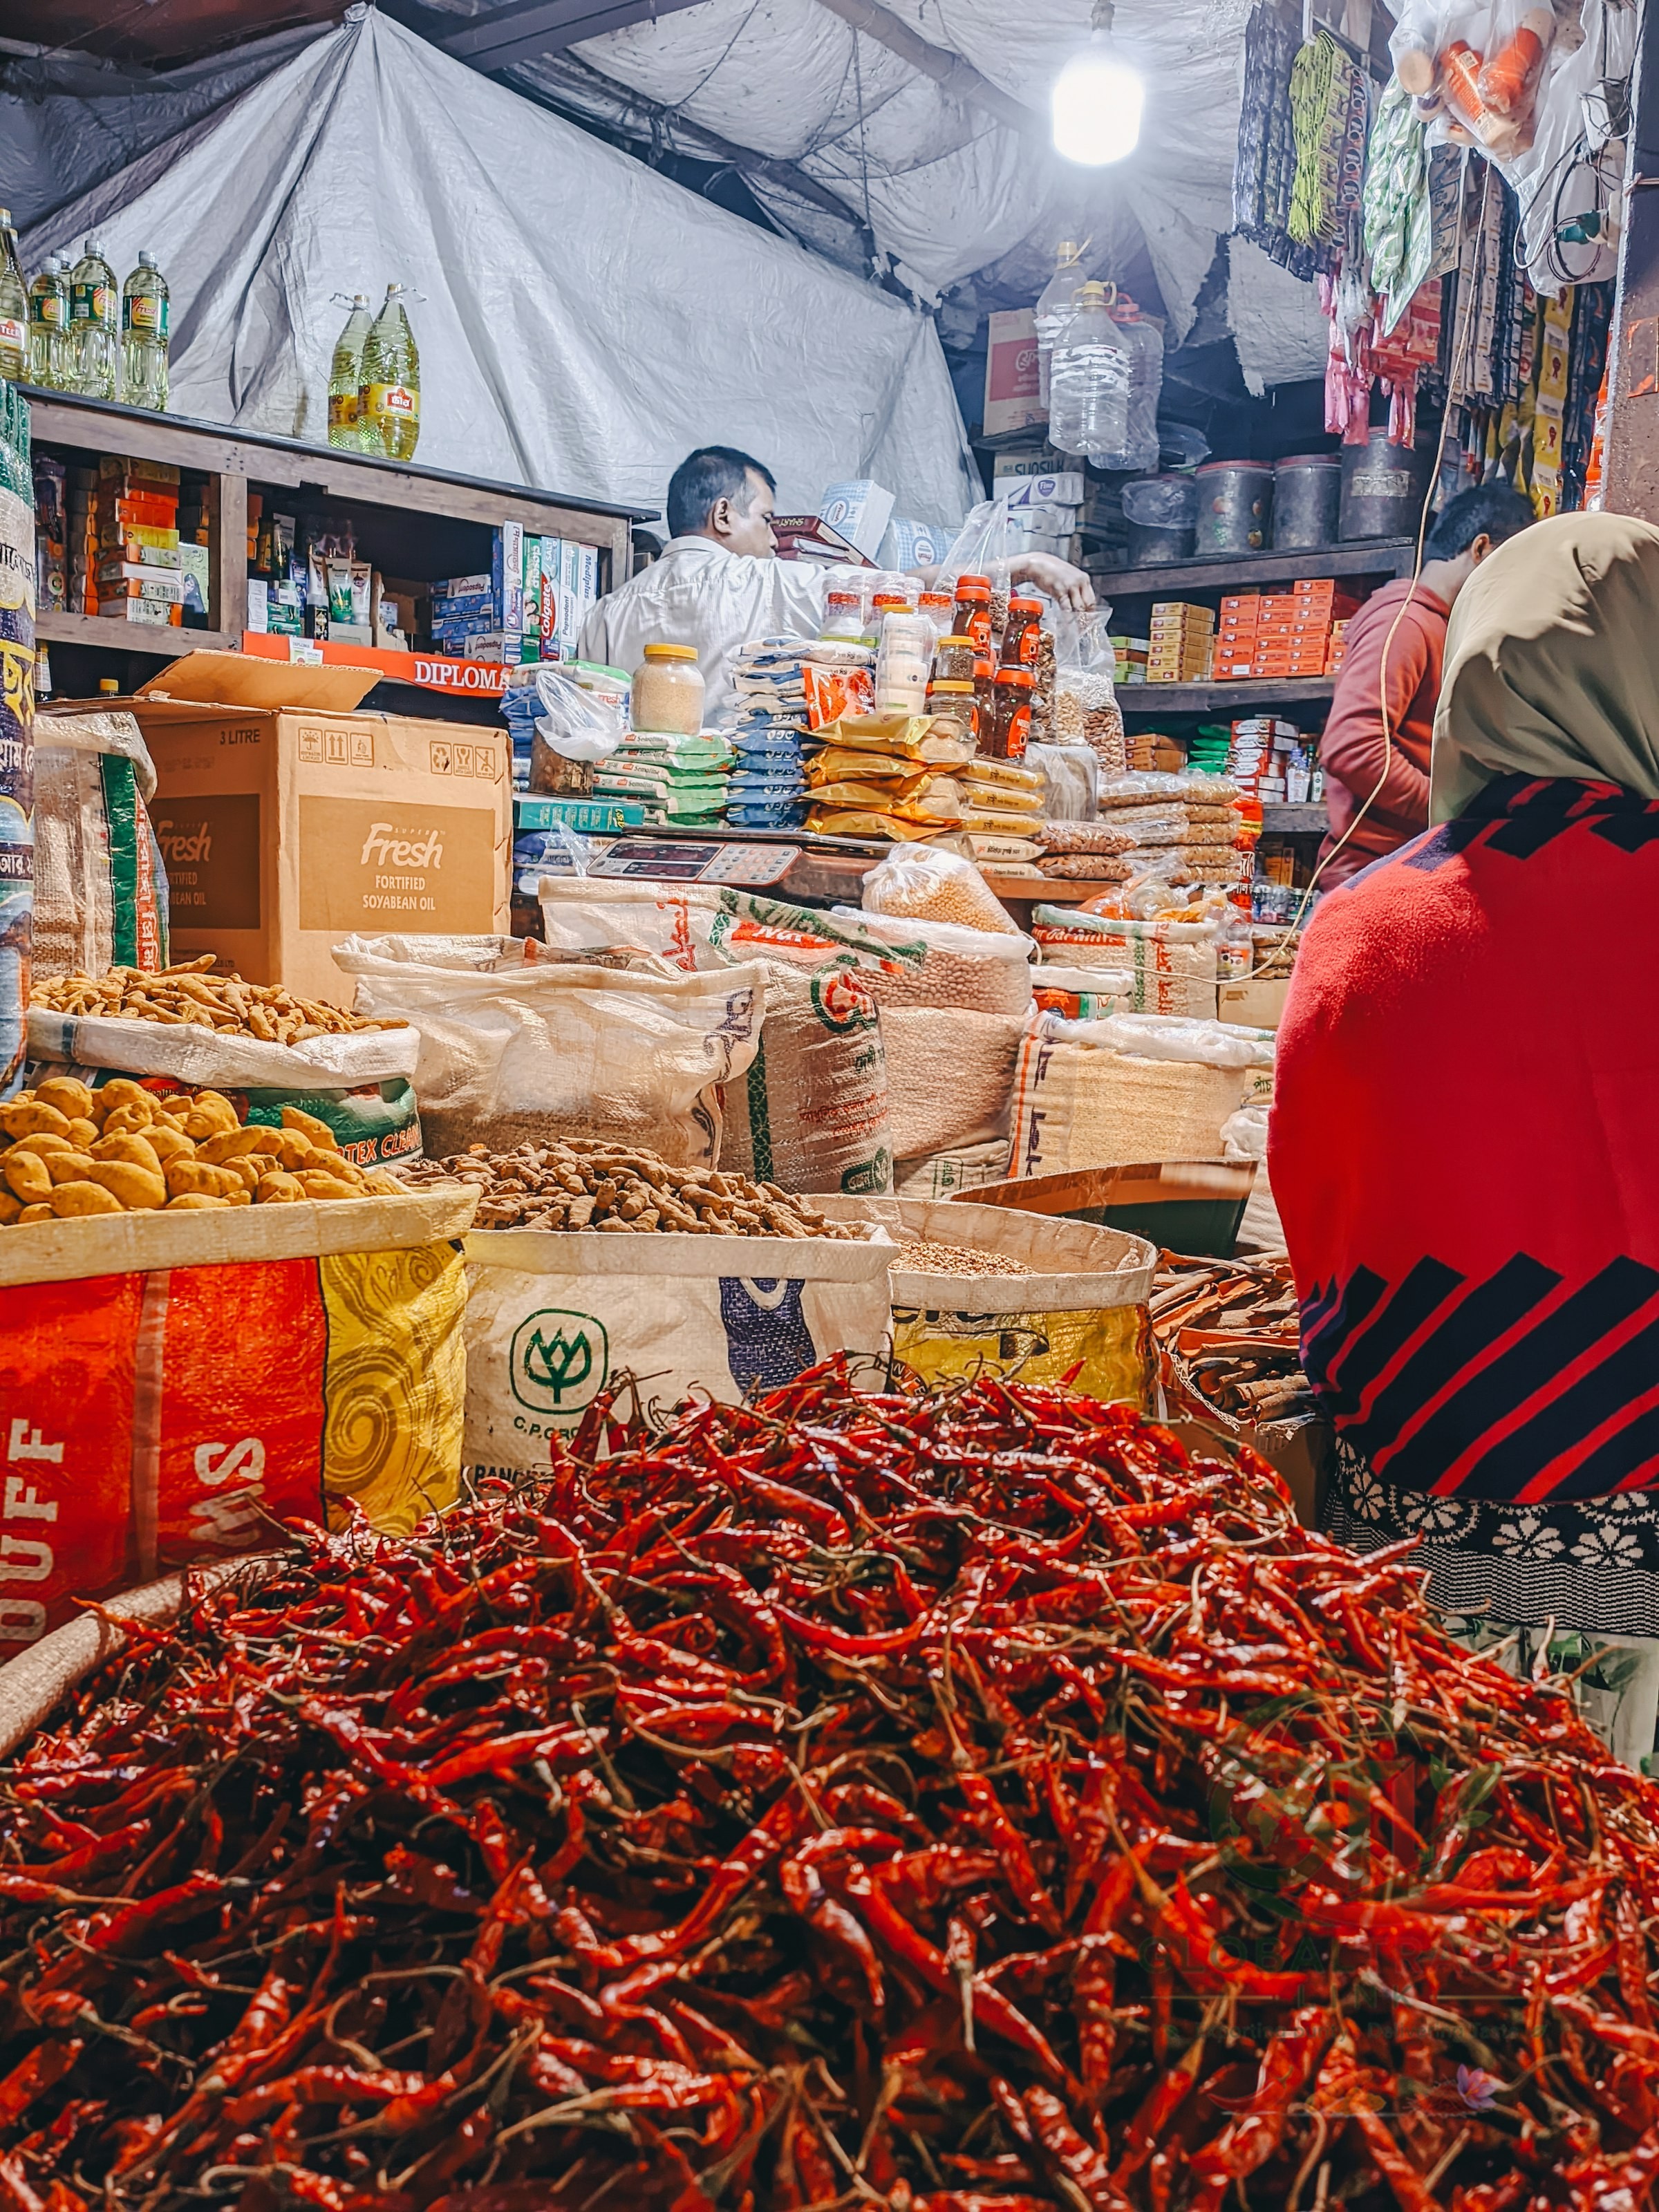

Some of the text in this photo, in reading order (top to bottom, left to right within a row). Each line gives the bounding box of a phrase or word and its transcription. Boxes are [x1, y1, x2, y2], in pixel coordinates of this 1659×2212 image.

[778, 517, 805, 527] SMART
[545, 540, 553, 561] SALT
[583, 554, 592, 600] Mediplus
[458, 582, 485, 594] Pepsodent
[541, 582, 552, 638] Colgate
[475, 639, 503, 651] Pepsodent
[219, 728, 261, 745] 3 LITRE
[360, 822, 444, 870] Fresh
[375, 874, 426, 891] FORTIFIED
[193, 892, 207, 906] OIL
[362, 894, 436, 911] SOYABEAN OIL
